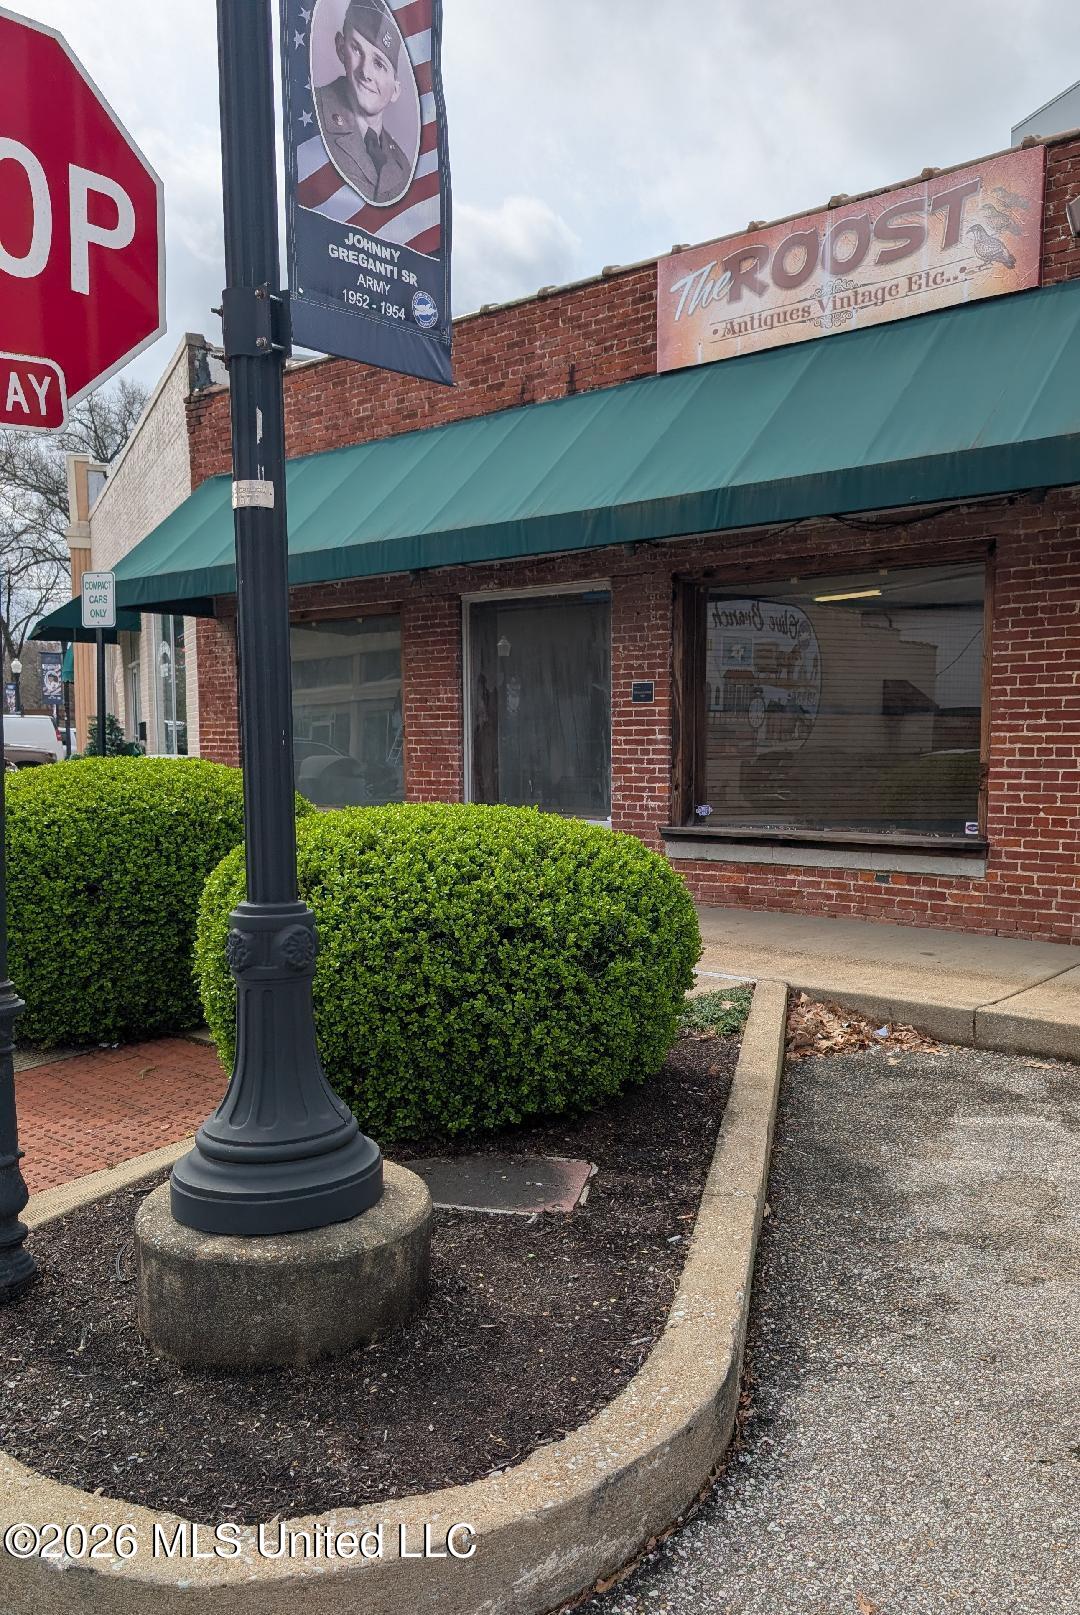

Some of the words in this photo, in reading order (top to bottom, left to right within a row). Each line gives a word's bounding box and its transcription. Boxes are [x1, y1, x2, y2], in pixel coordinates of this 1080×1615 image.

[344, 233, 401, 263] JOHNNY
[670, 260, 733, 321] The
[721, 176, 982, 304] ROOST
[328, 243, 398, 280] GREGANTI
[401, 269, 419, 288] SR
[357, 273, 392, 296] ARMY
[342, 288, 370, 310] 1952
[380, 301, 406, 321] 1954
[719, 304, 812, 338] Antiques
[815, 283, 900, 315] Vintage
[88, 594, 108, 604] CARS
[90, 608, 108, 618] ONLY
